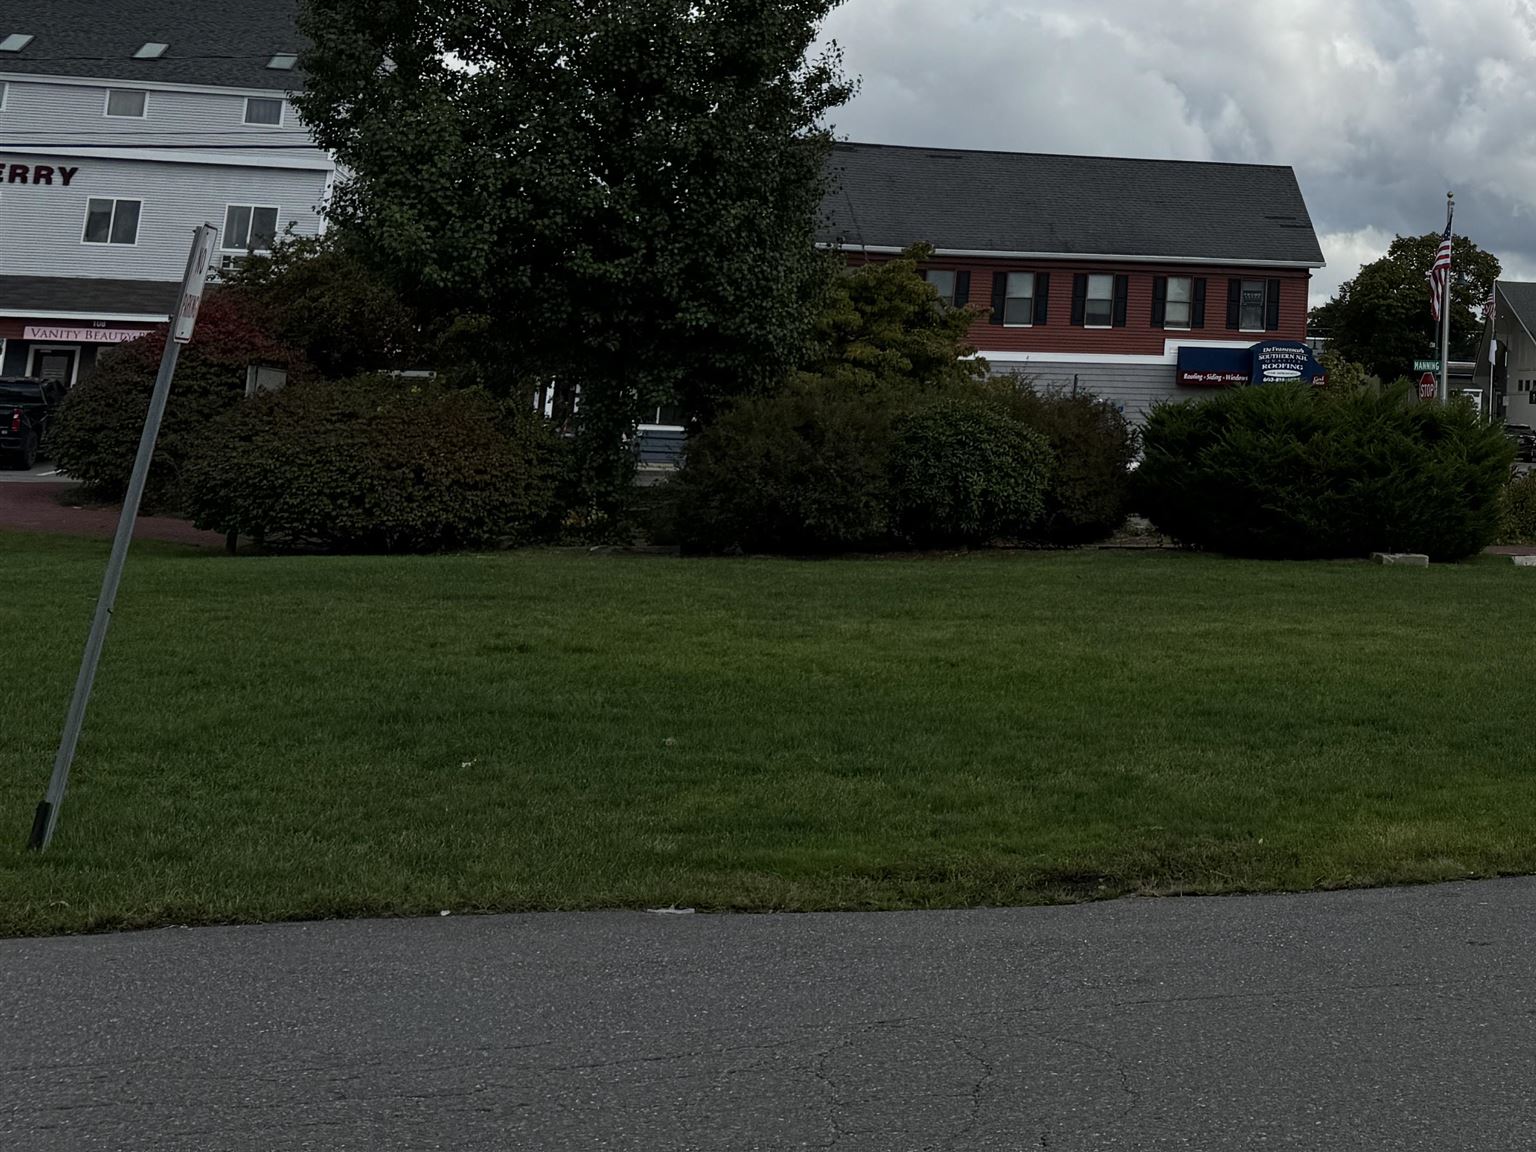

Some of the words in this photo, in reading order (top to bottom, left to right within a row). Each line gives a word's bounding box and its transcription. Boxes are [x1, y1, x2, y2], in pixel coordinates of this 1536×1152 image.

[31, 328, 82, 339] VANITY
[85, 330, 135, 341] BEAUTY
[1414, 361, 1440, 370] MANNING
[1183, 372, 1203, 382] Roofing
[1206, 373, 1222, 382] Siding
[1225, 373, 1249, 381] Windows
[1421, 383, 1434, 397] STOP
